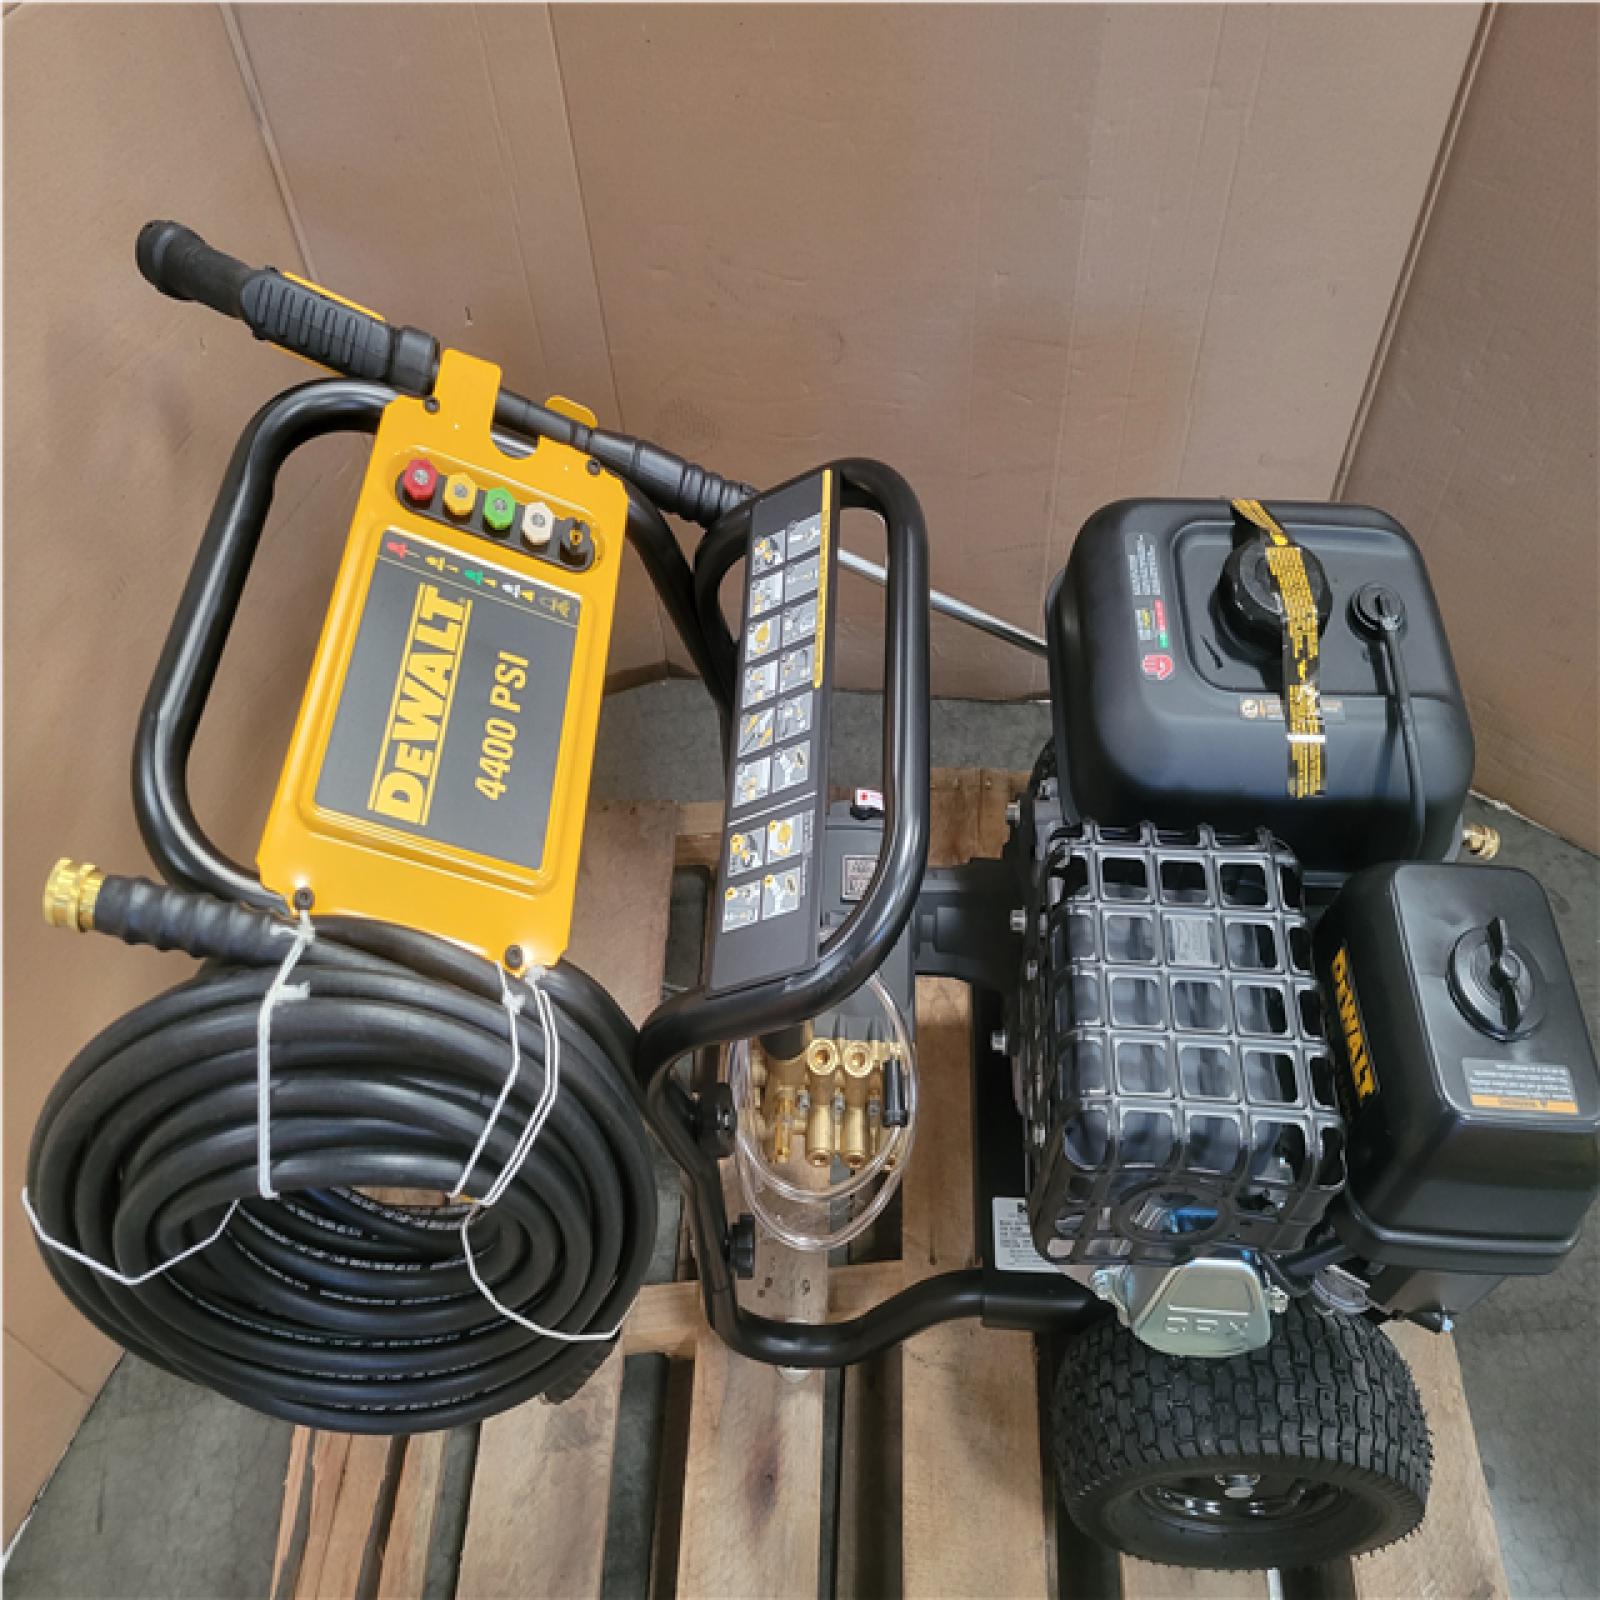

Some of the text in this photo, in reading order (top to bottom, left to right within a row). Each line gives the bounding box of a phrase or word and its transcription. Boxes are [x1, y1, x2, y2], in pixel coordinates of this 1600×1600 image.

[368, 583, 473, 825] DEWALT
[474, 651, 530, 801] 4400 PSI
[1331, 945, 1378, 1100] DEWALT
